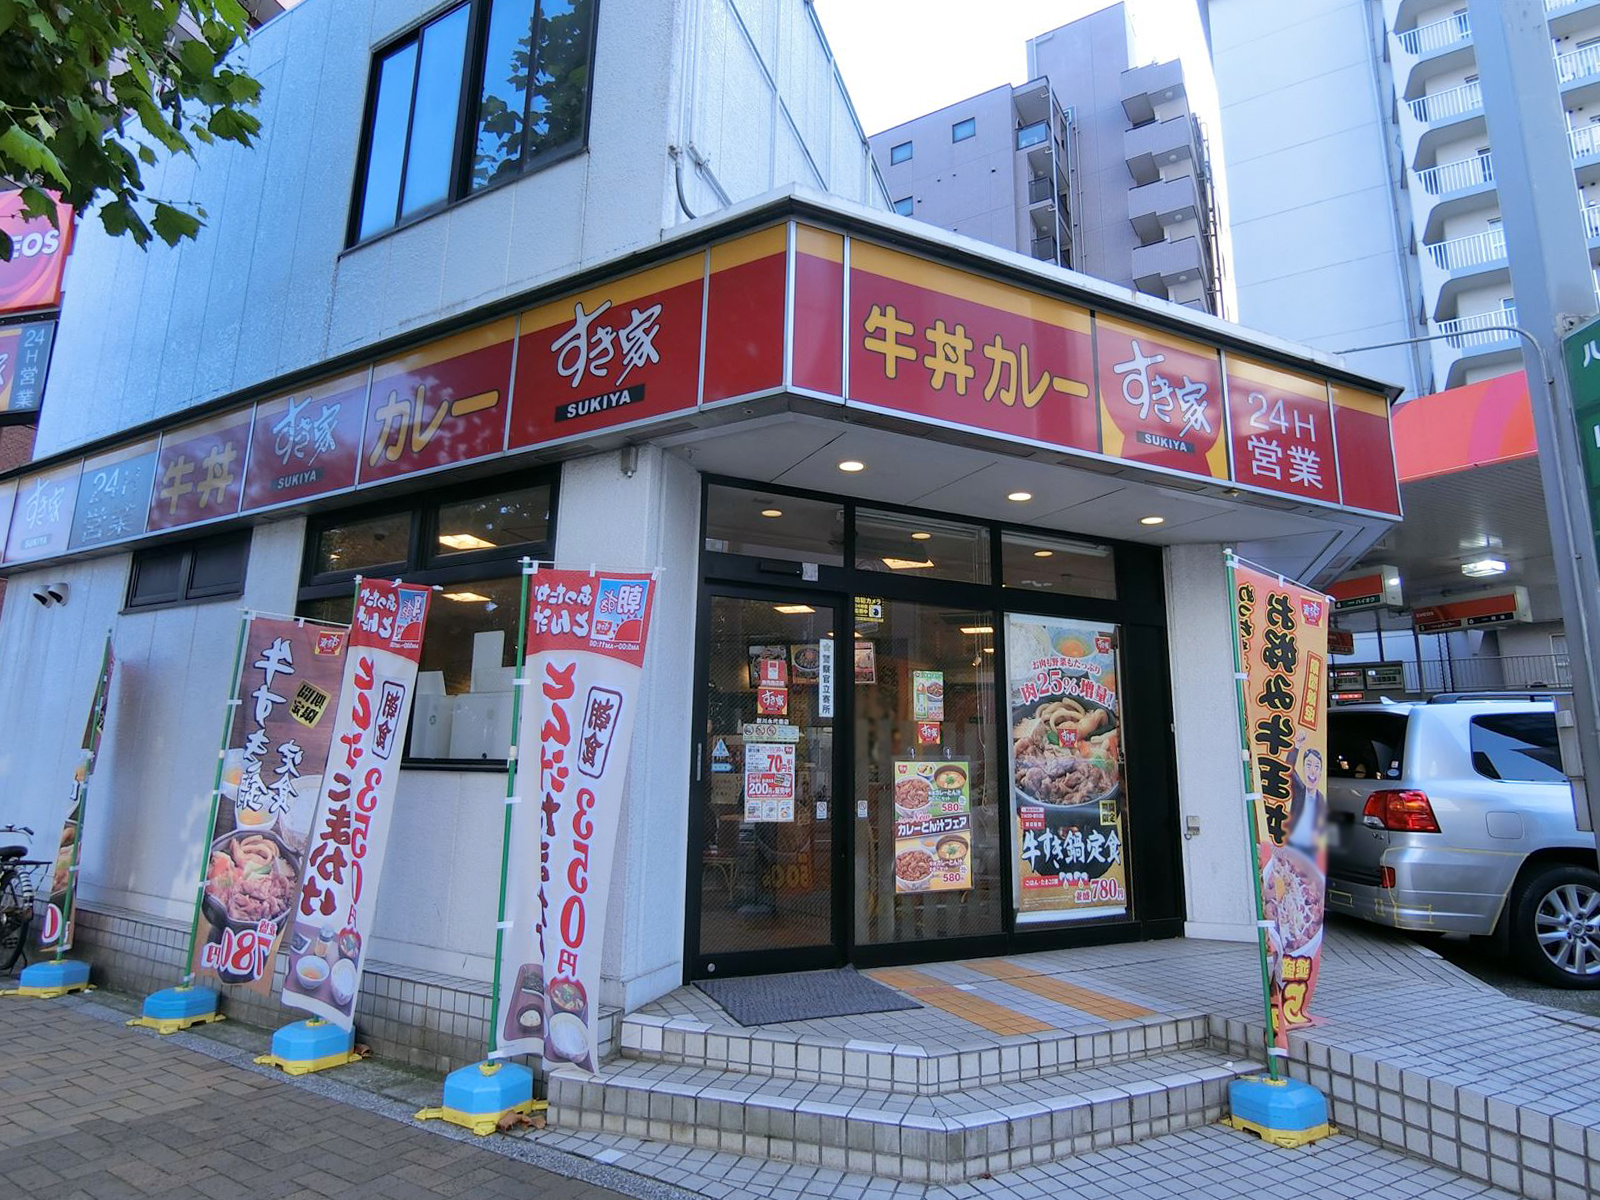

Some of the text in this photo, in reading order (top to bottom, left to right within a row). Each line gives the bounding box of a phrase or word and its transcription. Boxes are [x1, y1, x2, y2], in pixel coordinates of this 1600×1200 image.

[551, 299, 663, 388] すき家
[863, 304, 1090, 408] 牛丼カレー
[566, 389, 631, 419] SUKIYA
[1113, 339, 1212, 437] すき家
[273, 396, 342, 466] すき家
[369, 384, 500, 467] カレー
[1144, 434, 1188, 453] SUKIYA
[1248, 391, 1317, 443] 24H
[160, 441, 238, 515] 牛丼
[277, 471, 317, 489] SUKIYA
[1247, 436, 1324, 490] 営業
[821, 654, 832, 715] 警察官立寄所
[1032, 658, 1102, 675] お肉も野菜もたっぷり
[762, 690, 784, 707] すき家
[897, 815, 967, 837] カレーとん汁フェア
[1021, 828, 1122, 874] 牛すき鍋定食
